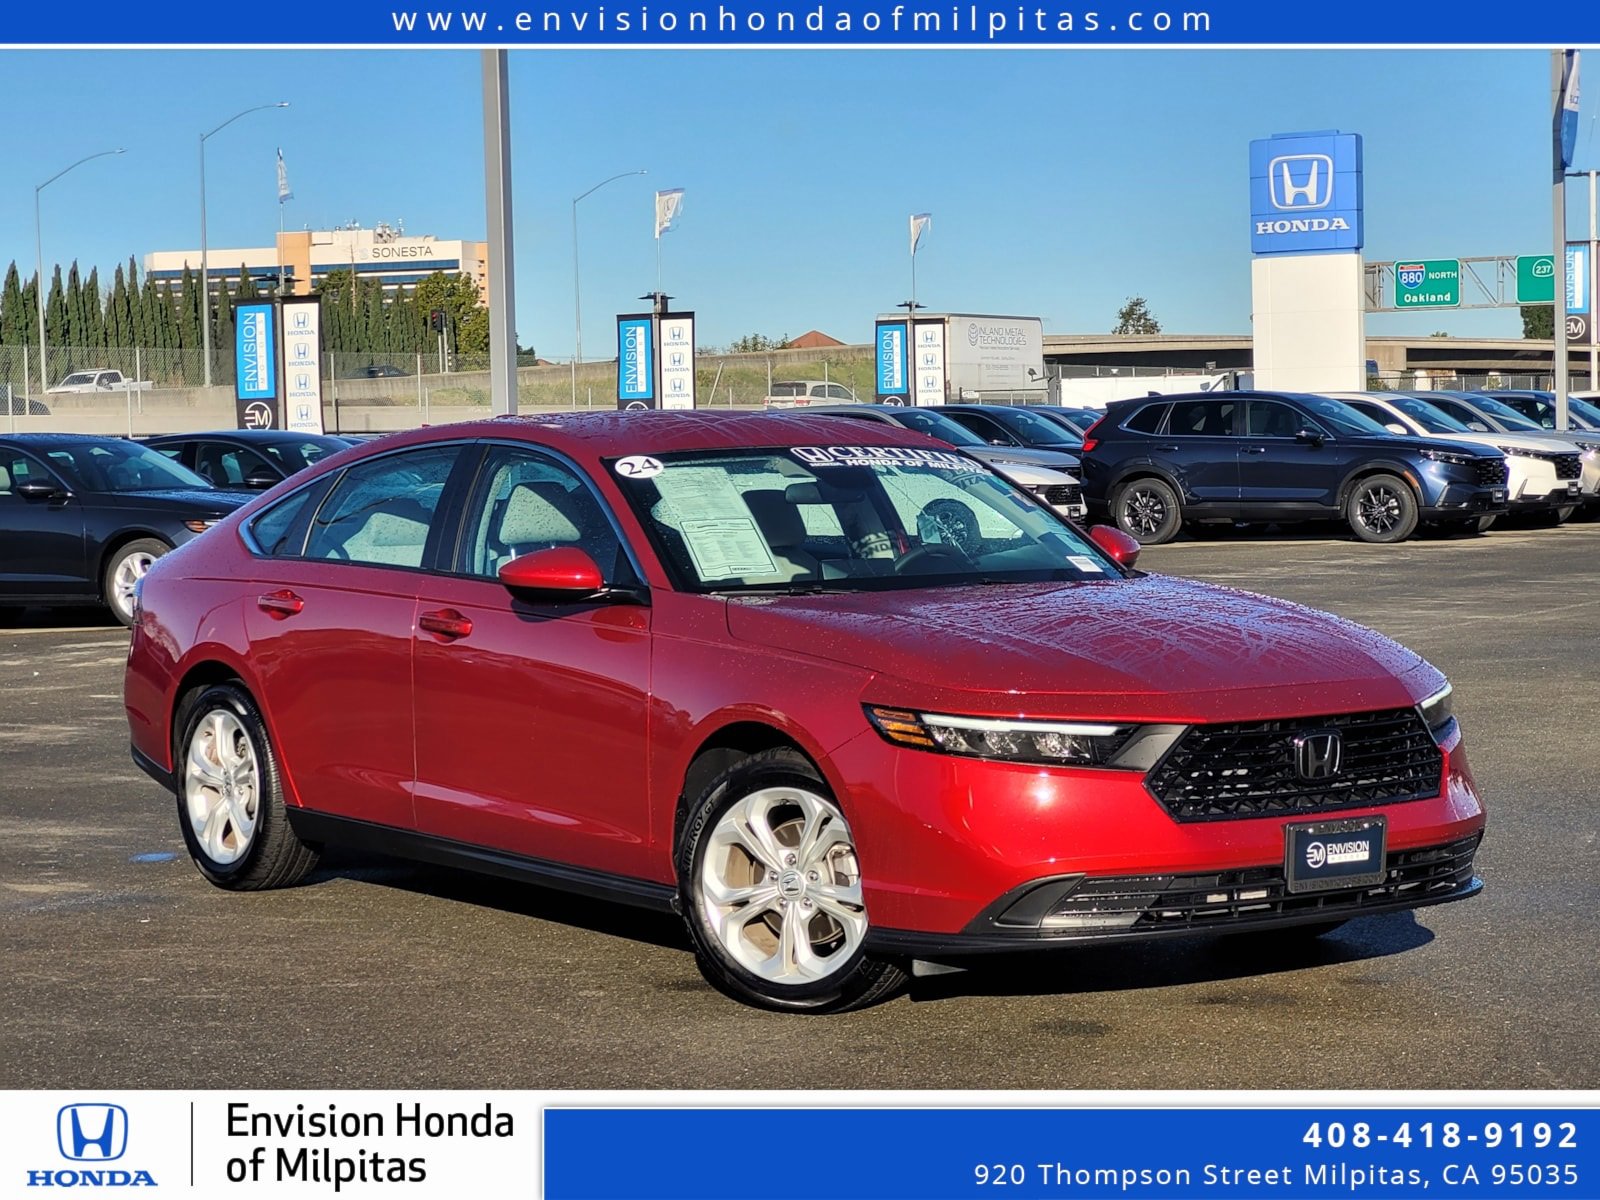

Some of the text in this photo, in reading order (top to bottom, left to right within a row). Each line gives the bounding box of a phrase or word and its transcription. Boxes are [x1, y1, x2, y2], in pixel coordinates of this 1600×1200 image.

[1256, 217, 1350, 235] HONDA
[372, 246, 433, 258] SONESTA
[1535, 265, 1551, 274] 237
[1401, 271, 1457, 284] 880 NORTH
[1404, 292, 1451, 302] Oakland
[979, 327, 1026, 337] INLAND METAL
[979, 336, 1027, 346] TECHNOLOGIES
[243, 312, 257, 391] ENVISION
[625, 326, 638, 393] ENVISION
[883, 330, 894, 389] ENVISION
[620, 458, 660, 475] 24
[846, 459, 900, 467] HONDA
[1327, 840, 1369, 855] ENVISION
